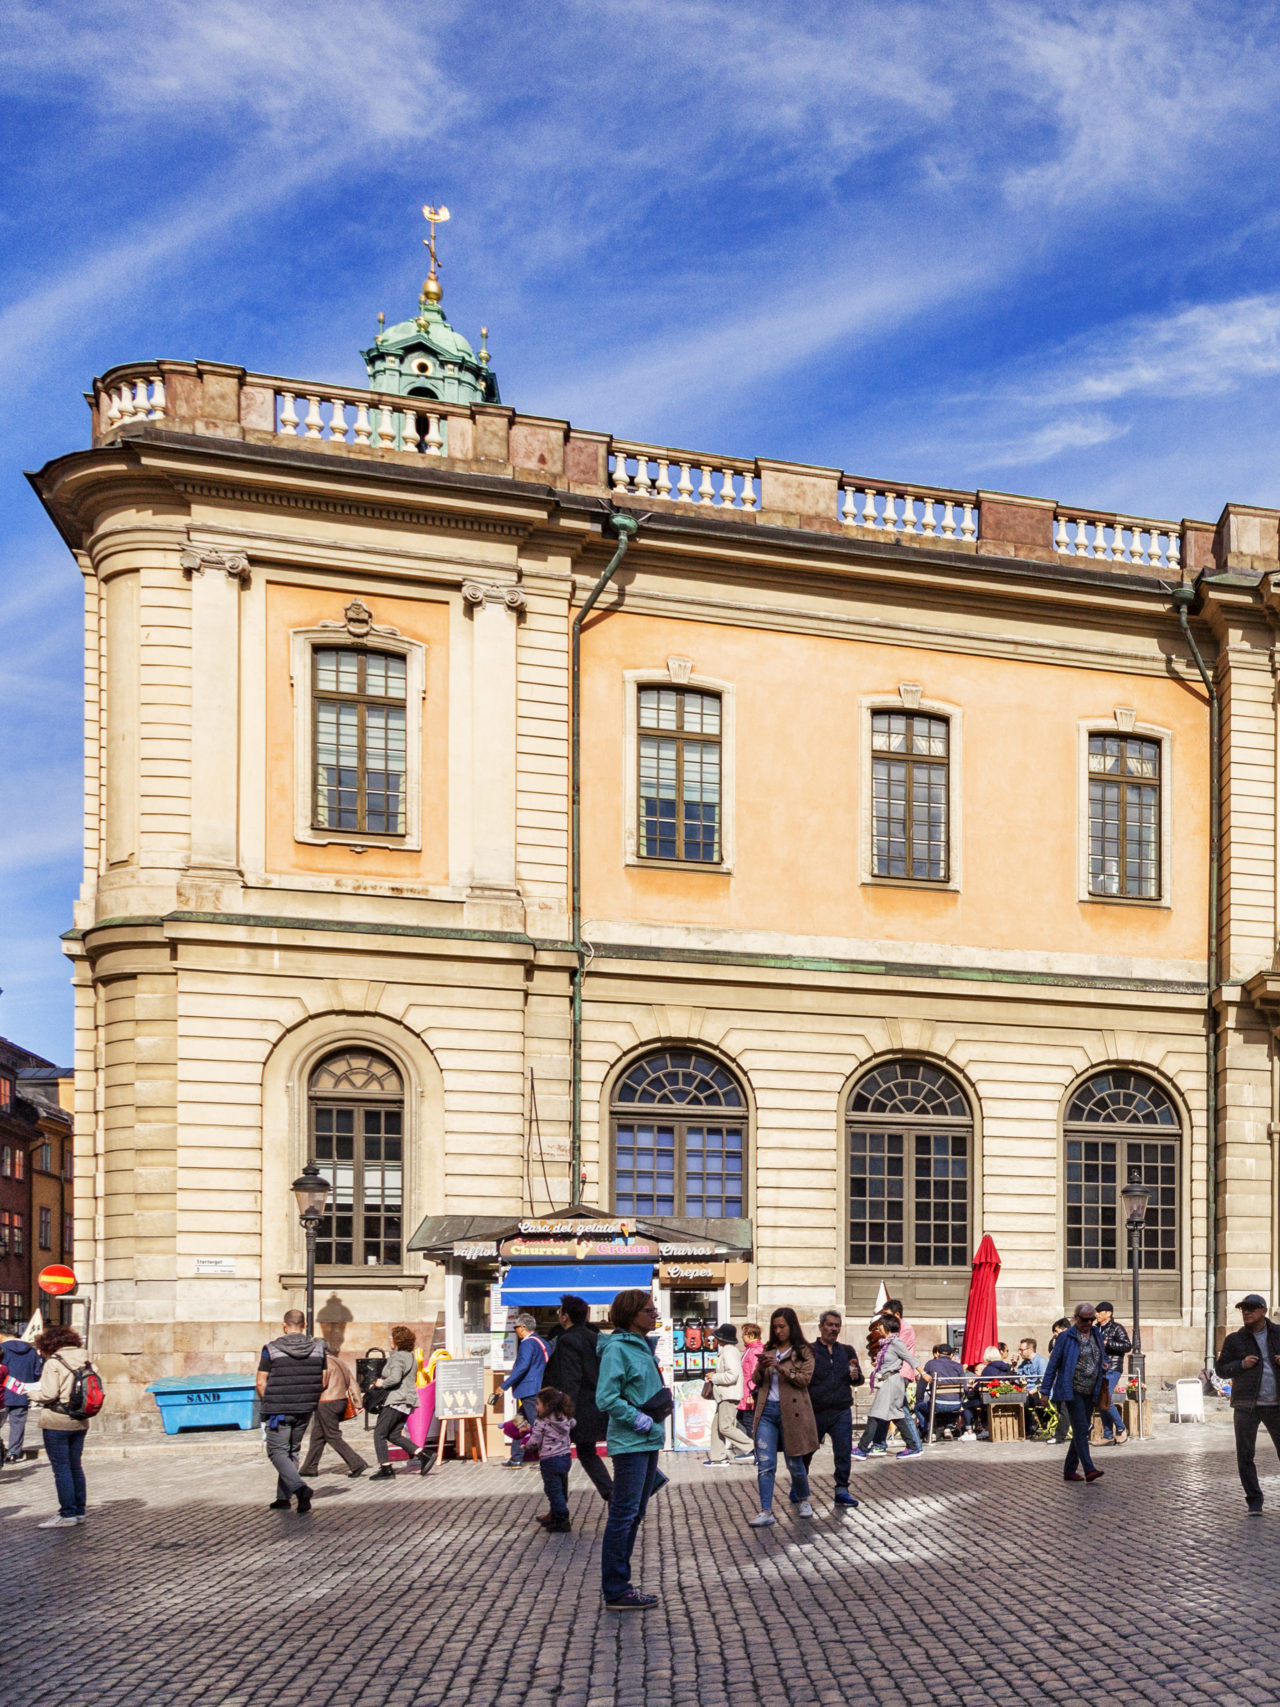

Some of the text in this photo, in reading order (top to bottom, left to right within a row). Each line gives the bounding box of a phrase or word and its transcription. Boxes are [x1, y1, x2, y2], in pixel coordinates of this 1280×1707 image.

[518, 1221, 616, 1236] Casa del gelato
[510, 1245, 568, 1255] Churros
[597, 1243, 650, 1254] Cream
[660, 1244, 712, 1256] Churros
[668, 1264, 713, 1280] Crepes
[186, 1392, 221, 1403] SAND
